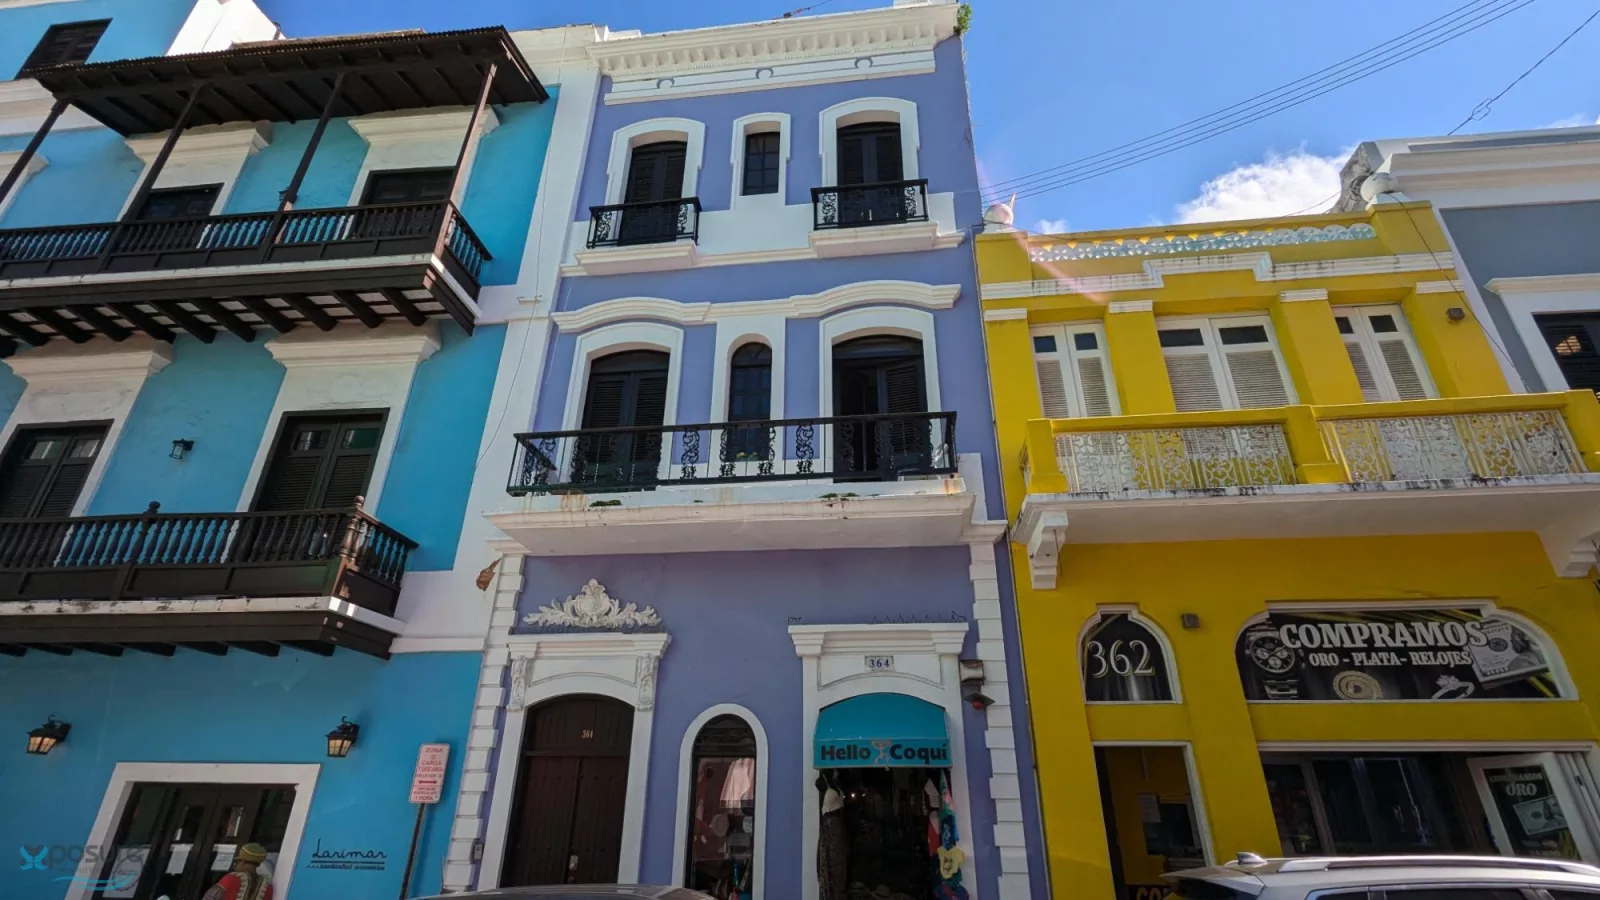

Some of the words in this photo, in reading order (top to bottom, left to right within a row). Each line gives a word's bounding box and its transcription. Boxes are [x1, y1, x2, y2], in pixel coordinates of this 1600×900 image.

[1279, 619, 1489, 649] COMPRAMOS
[869, 658, 890, 669] 364
[1088, 640, 1155, 678] 362
[1309, 651, 1339, 667] ORO
[1411, 650, 1473, 669] RELOJES
[821, 744, 872, 761] Hello
[889, 743, 948, 765] Coquí
[1506, 783, 1538, 796] ORO
[312, 838, 387, 859] Larimar
